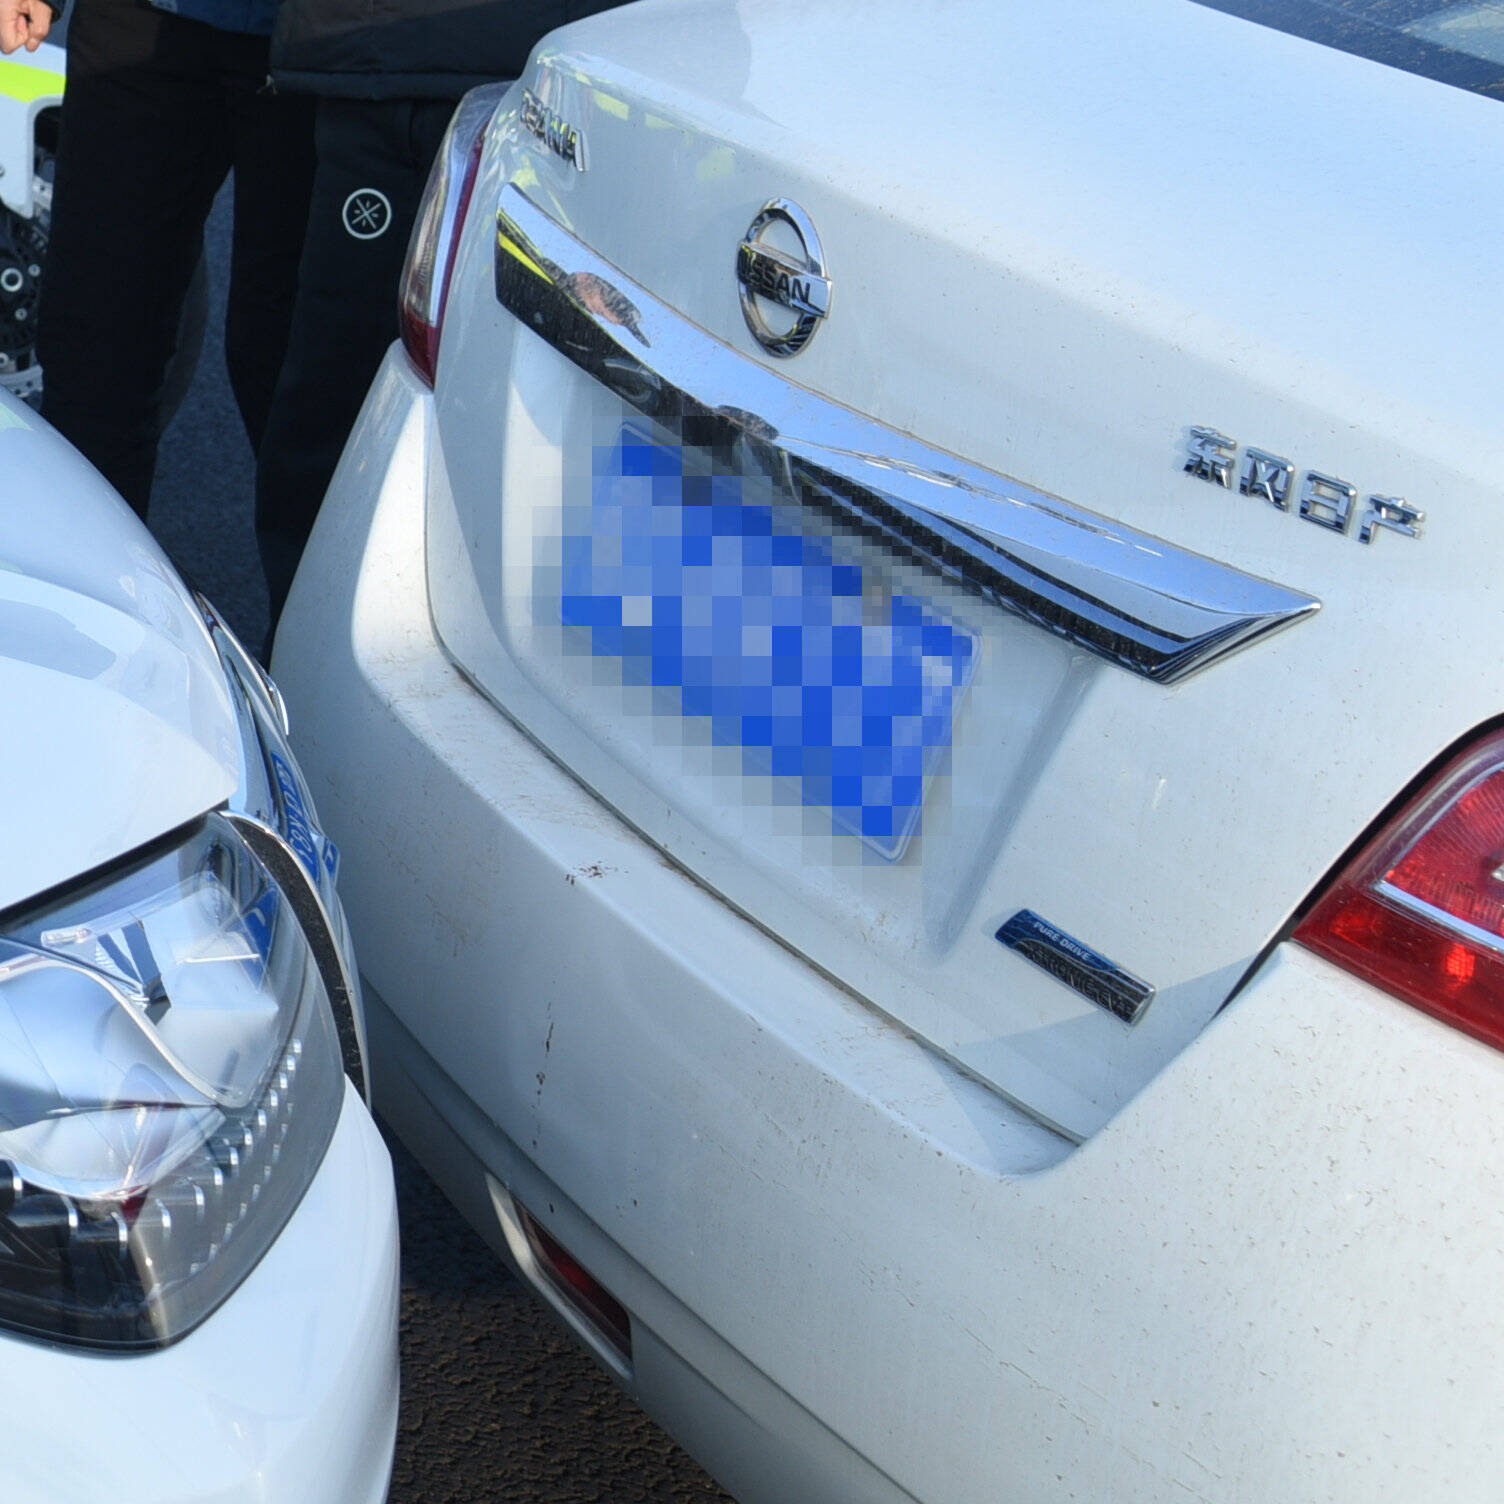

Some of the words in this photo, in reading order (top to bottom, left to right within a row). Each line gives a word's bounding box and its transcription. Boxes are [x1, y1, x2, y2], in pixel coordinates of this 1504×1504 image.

[1183, 424, 1428, 546] 东风日产
[1032, 920, 1062, 942] PURE
[1059, 938, 1092, 962] DRIVE
